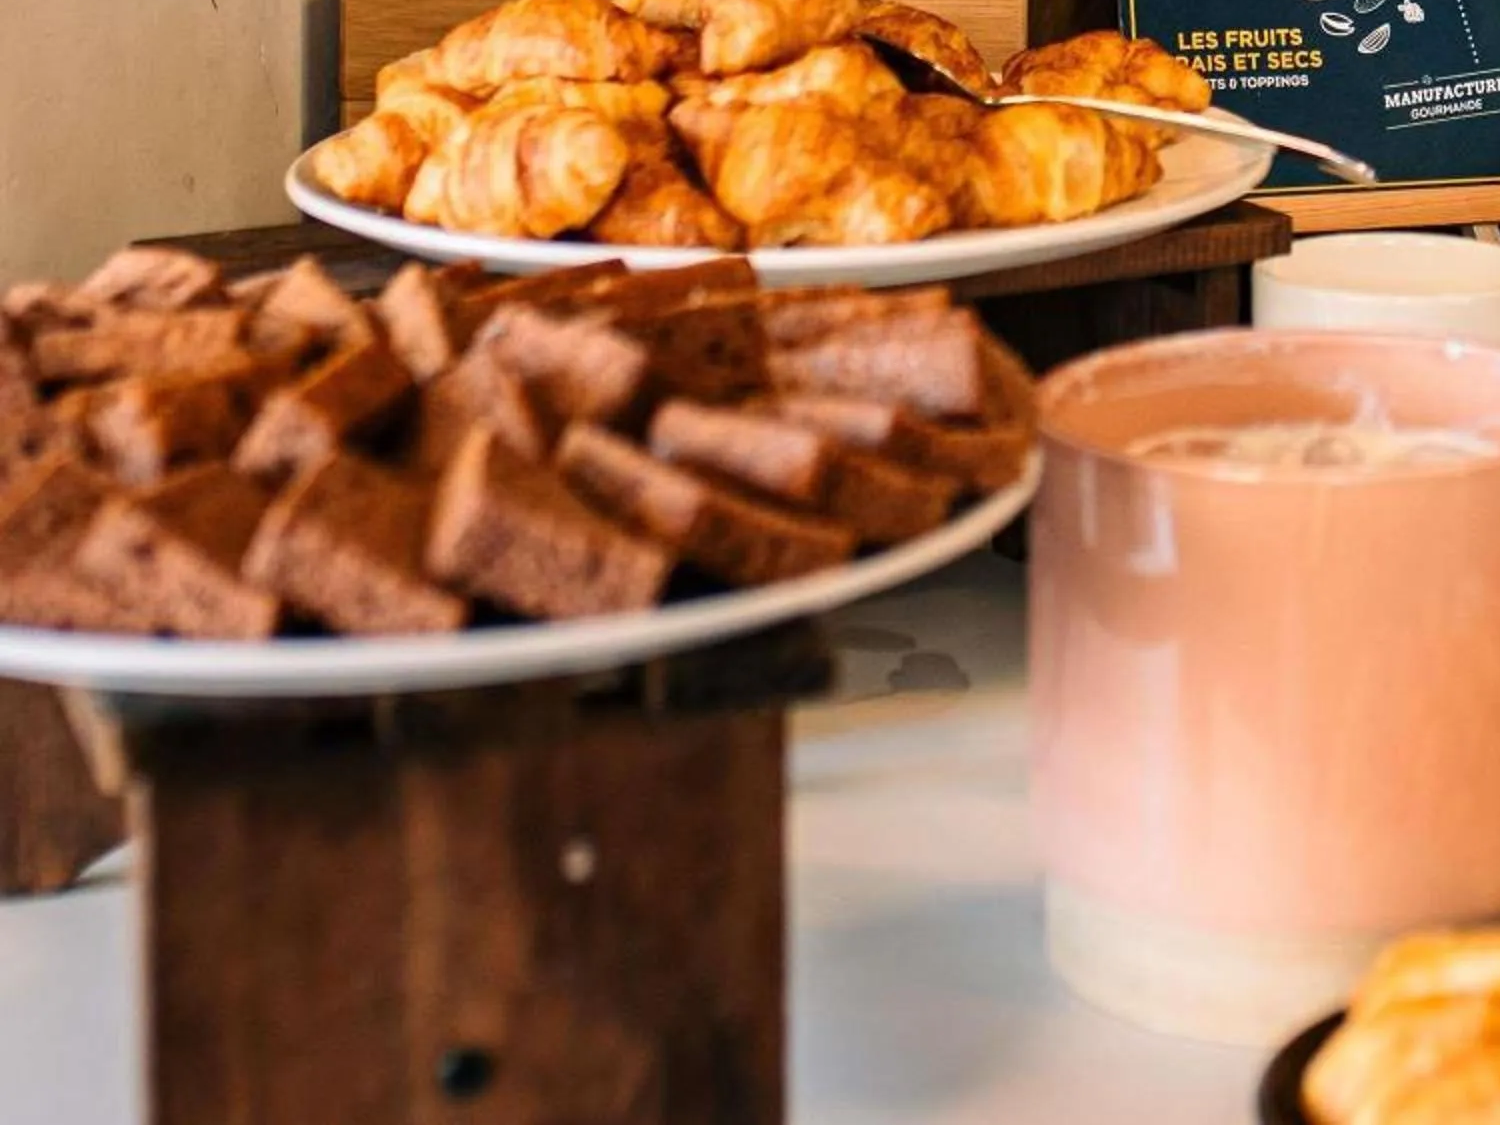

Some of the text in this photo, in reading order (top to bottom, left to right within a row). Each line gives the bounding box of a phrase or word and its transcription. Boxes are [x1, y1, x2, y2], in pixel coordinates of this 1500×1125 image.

[1178, 28, 1303, 50] LES FRUITS
[1175, 50, 1323, 73] AIS ET SECS
[1241, 74, 1310, 89] TOPPINGS
[1410, 99, 1483, 119] GOURMANDE
